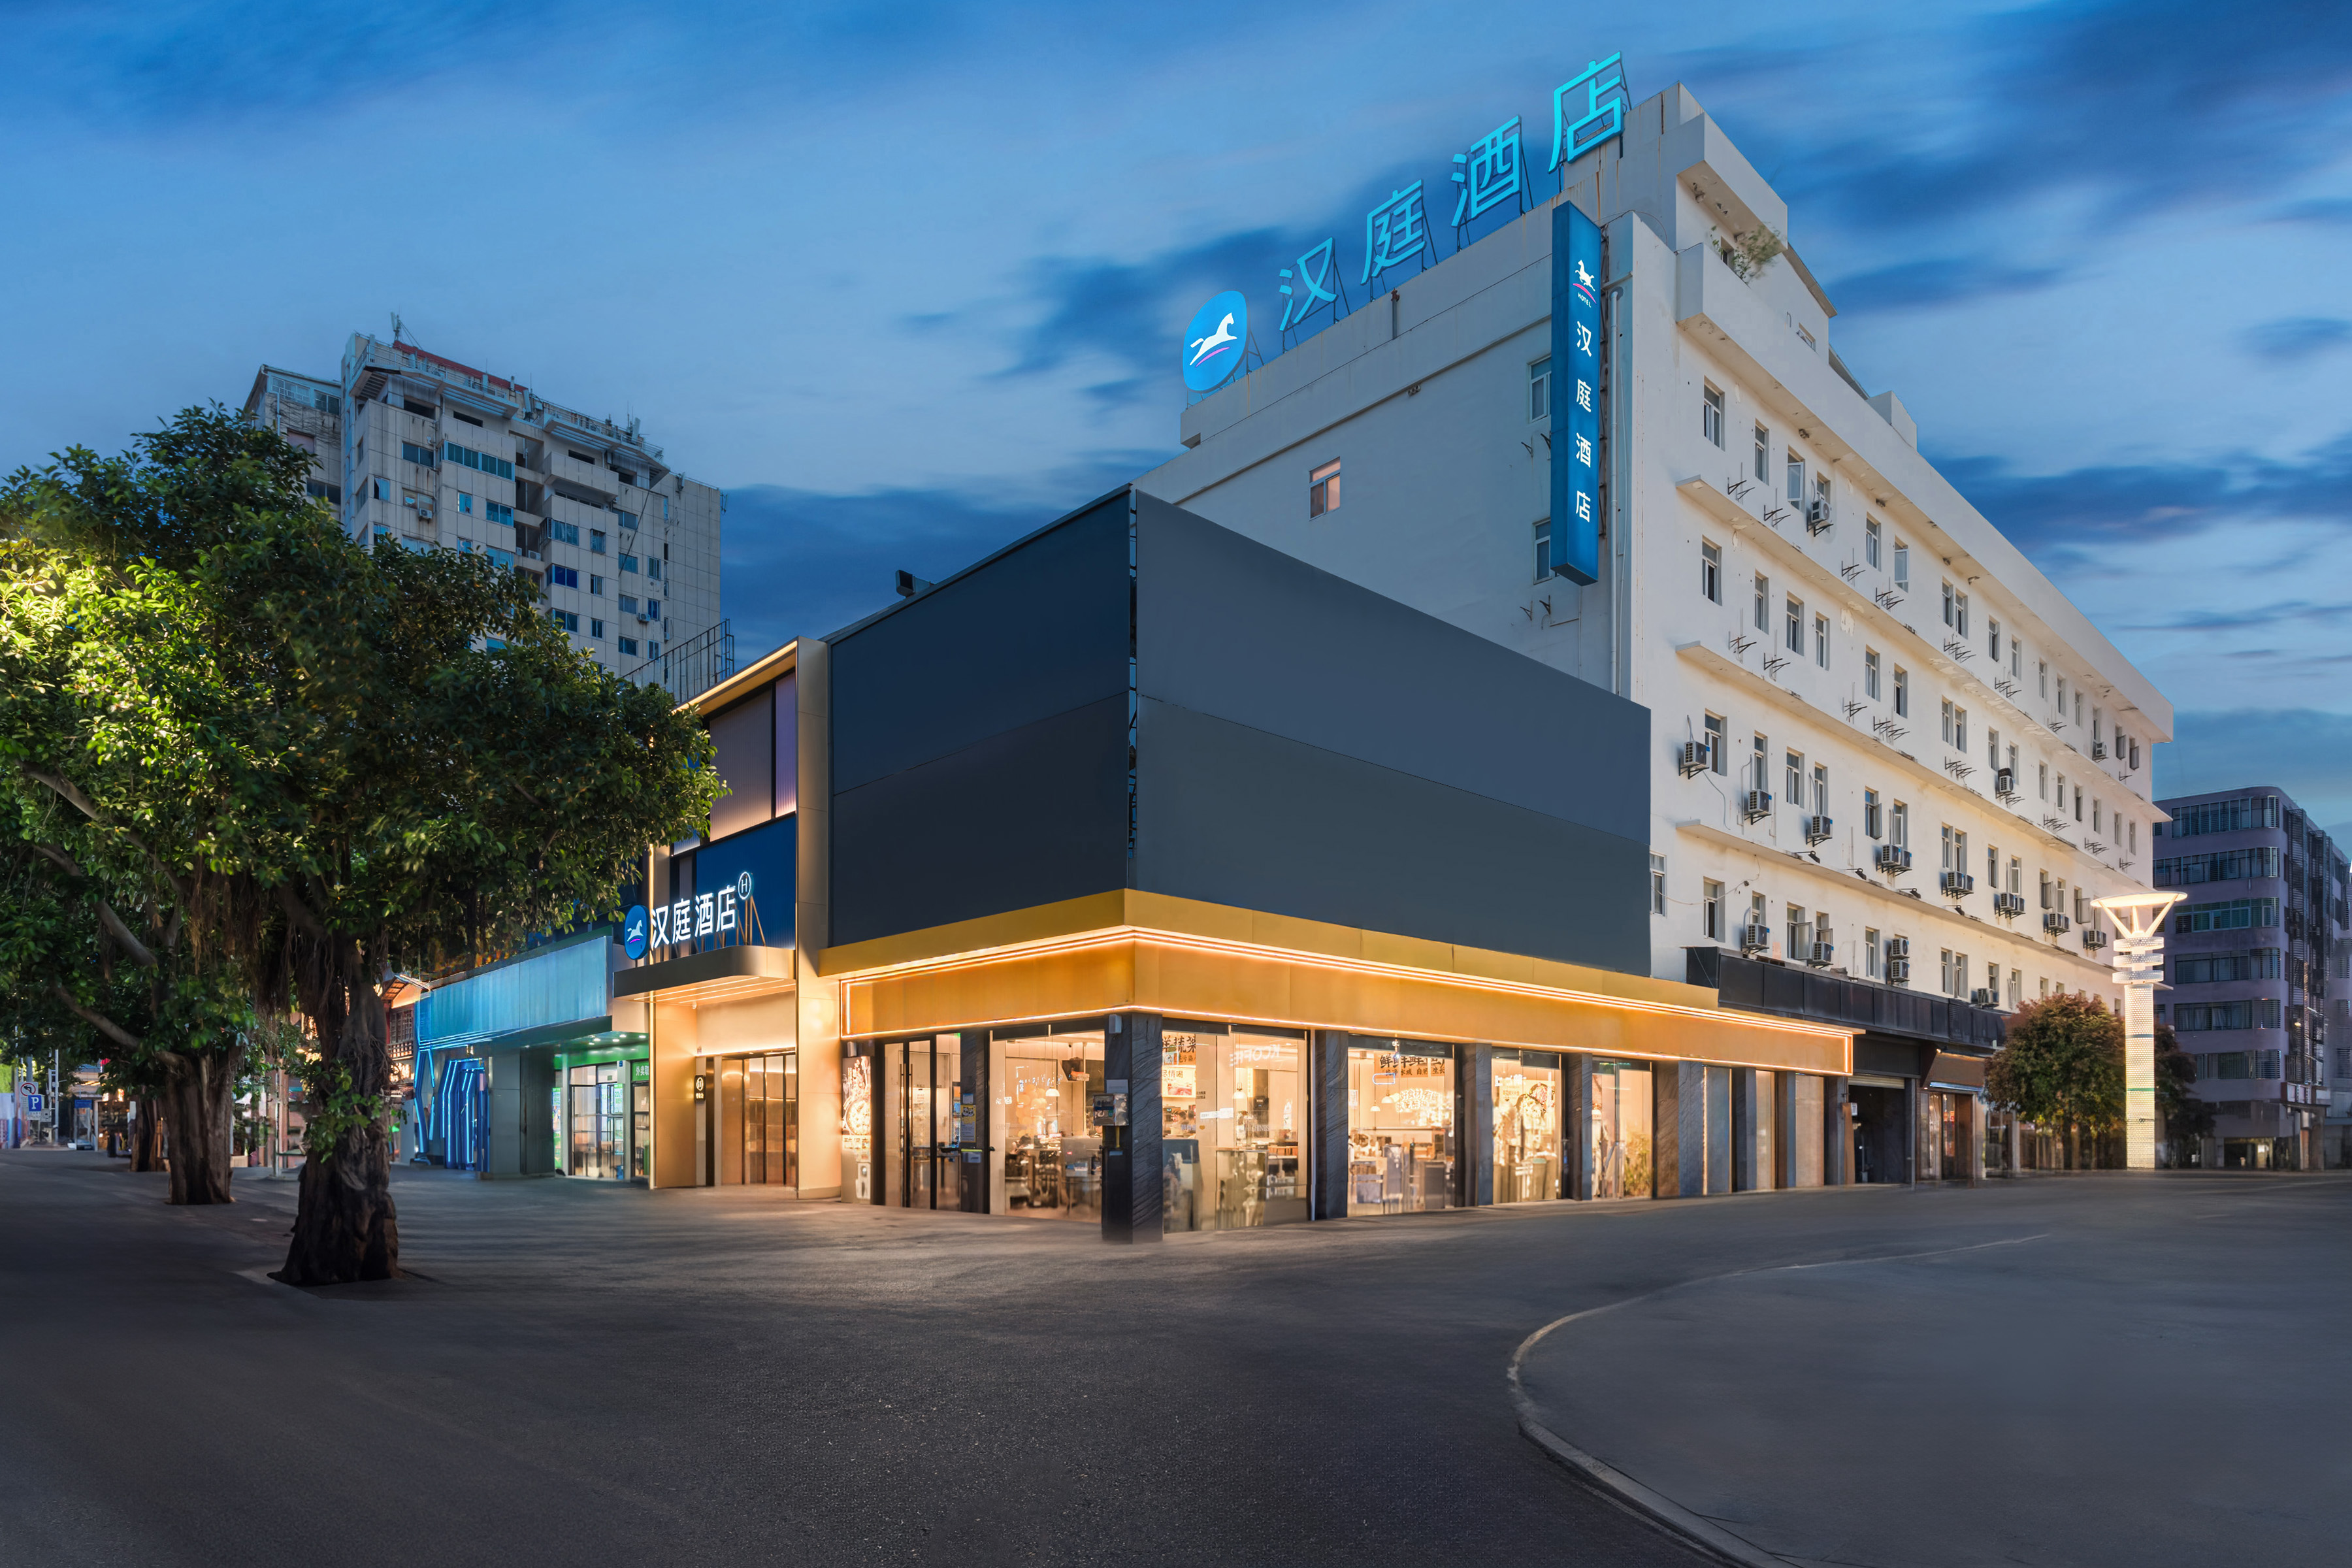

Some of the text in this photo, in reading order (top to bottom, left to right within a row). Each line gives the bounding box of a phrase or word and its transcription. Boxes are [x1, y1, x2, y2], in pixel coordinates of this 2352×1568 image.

[1278, 51, 1625, 331] 汉庭酒店
[1578, 292, 1592, 308] HOTEL
[1576, 321, 1592, 523] 汉庭酒店
[651, 884, 736, 949] 汉庭酒店
[31, 1097, 39, 1109] P
